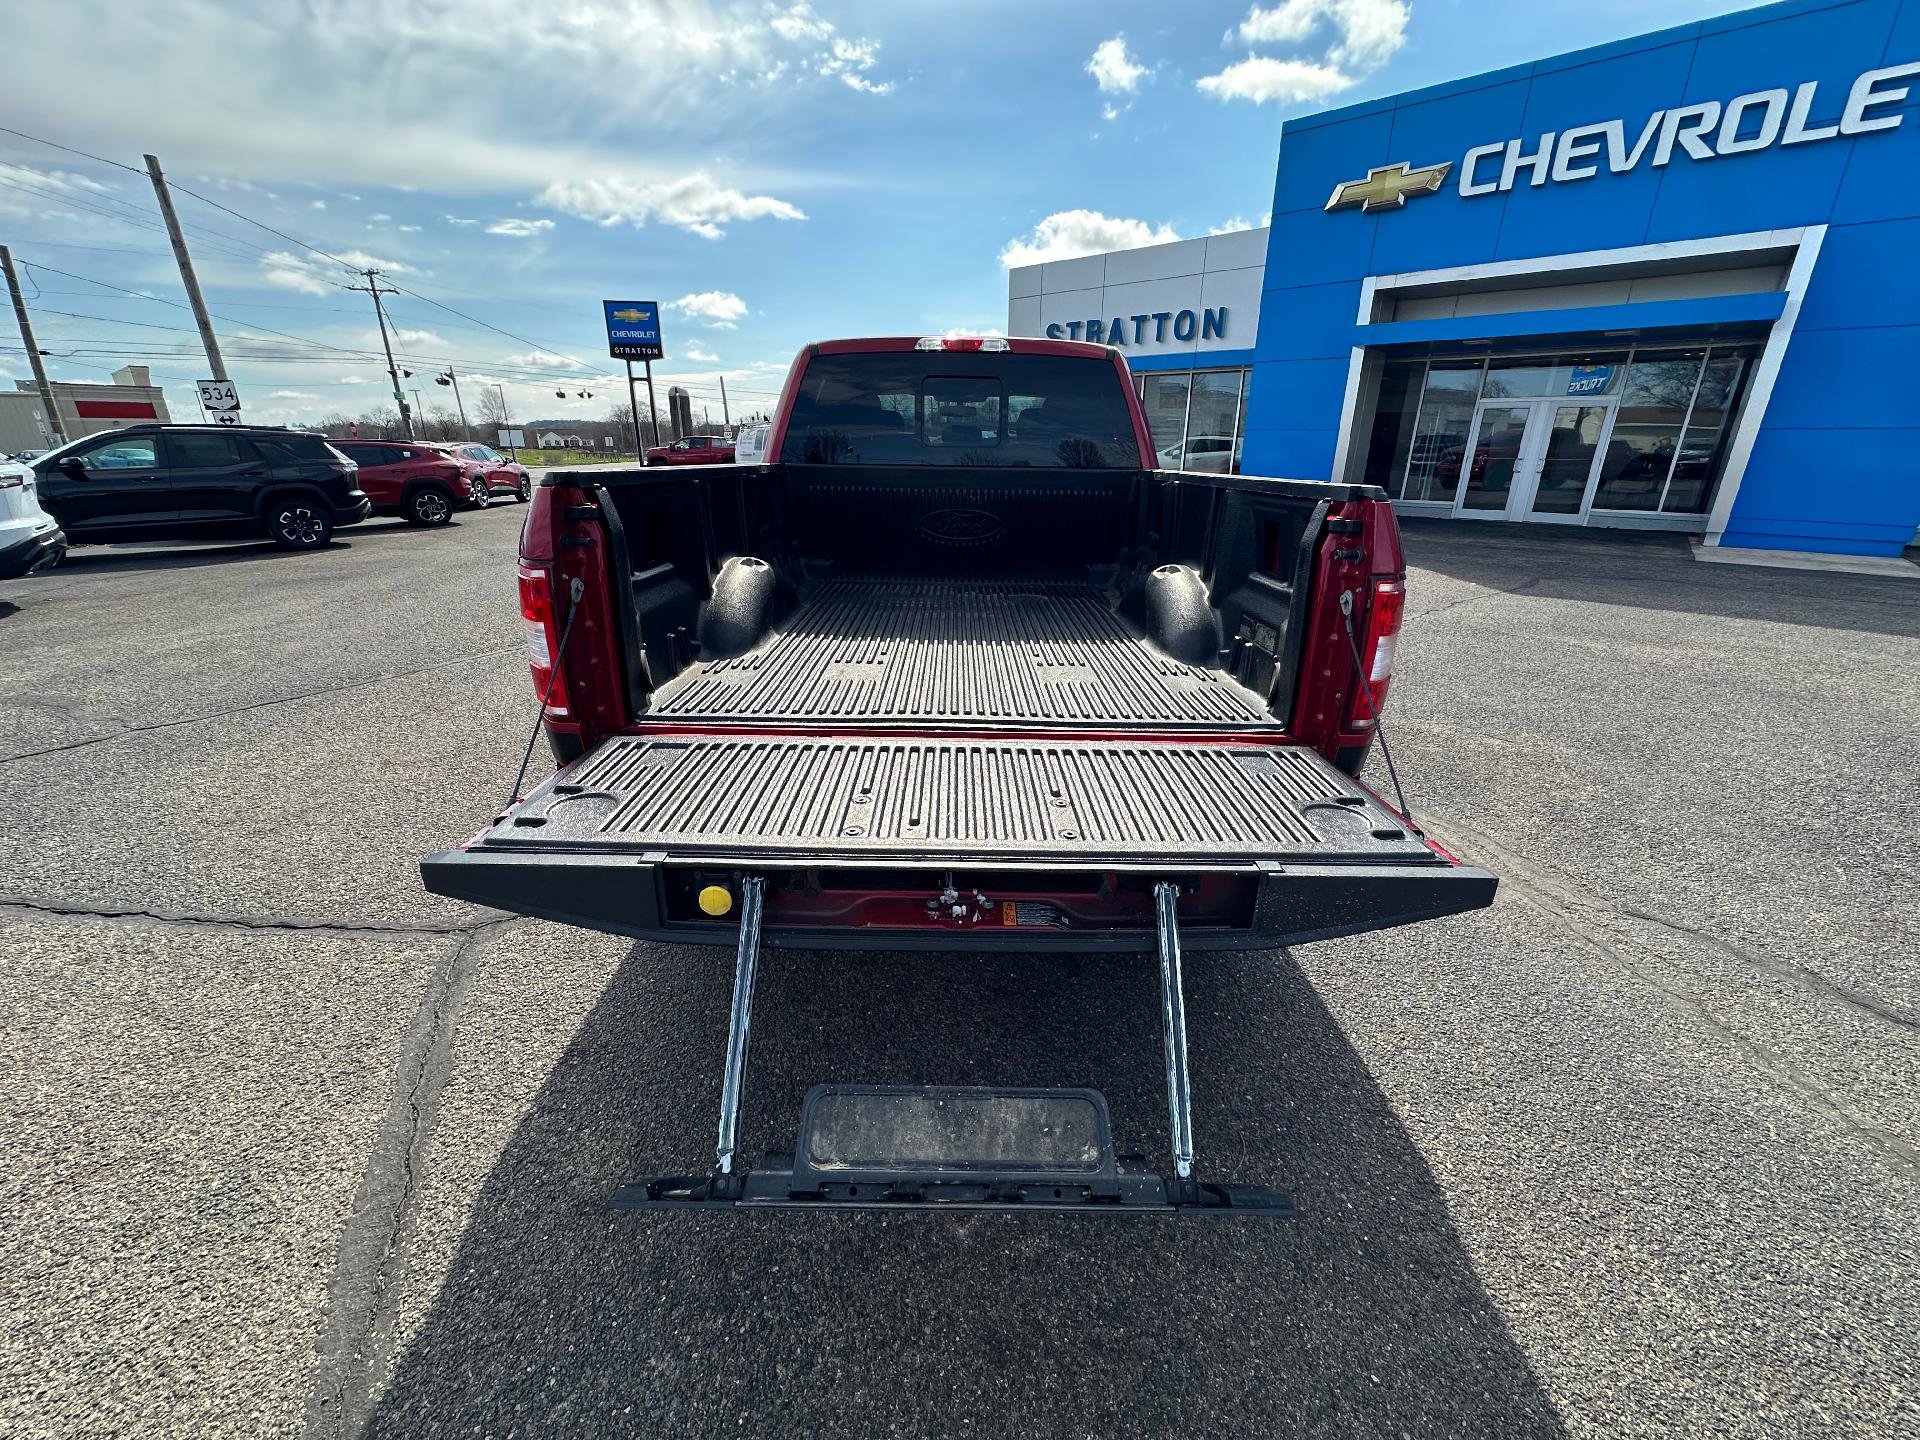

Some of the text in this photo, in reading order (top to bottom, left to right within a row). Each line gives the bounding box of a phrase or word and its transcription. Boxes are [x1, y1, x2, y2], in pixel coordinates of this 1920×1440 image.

[1045, 307, 1228, 346] STRATTON
[611, 330, 656, 338] CHEVROLET
[614, 346, 659, 355] STRATTON
[201, 387, 234, 401] 534
[935, 511, 987, 534] Ford
